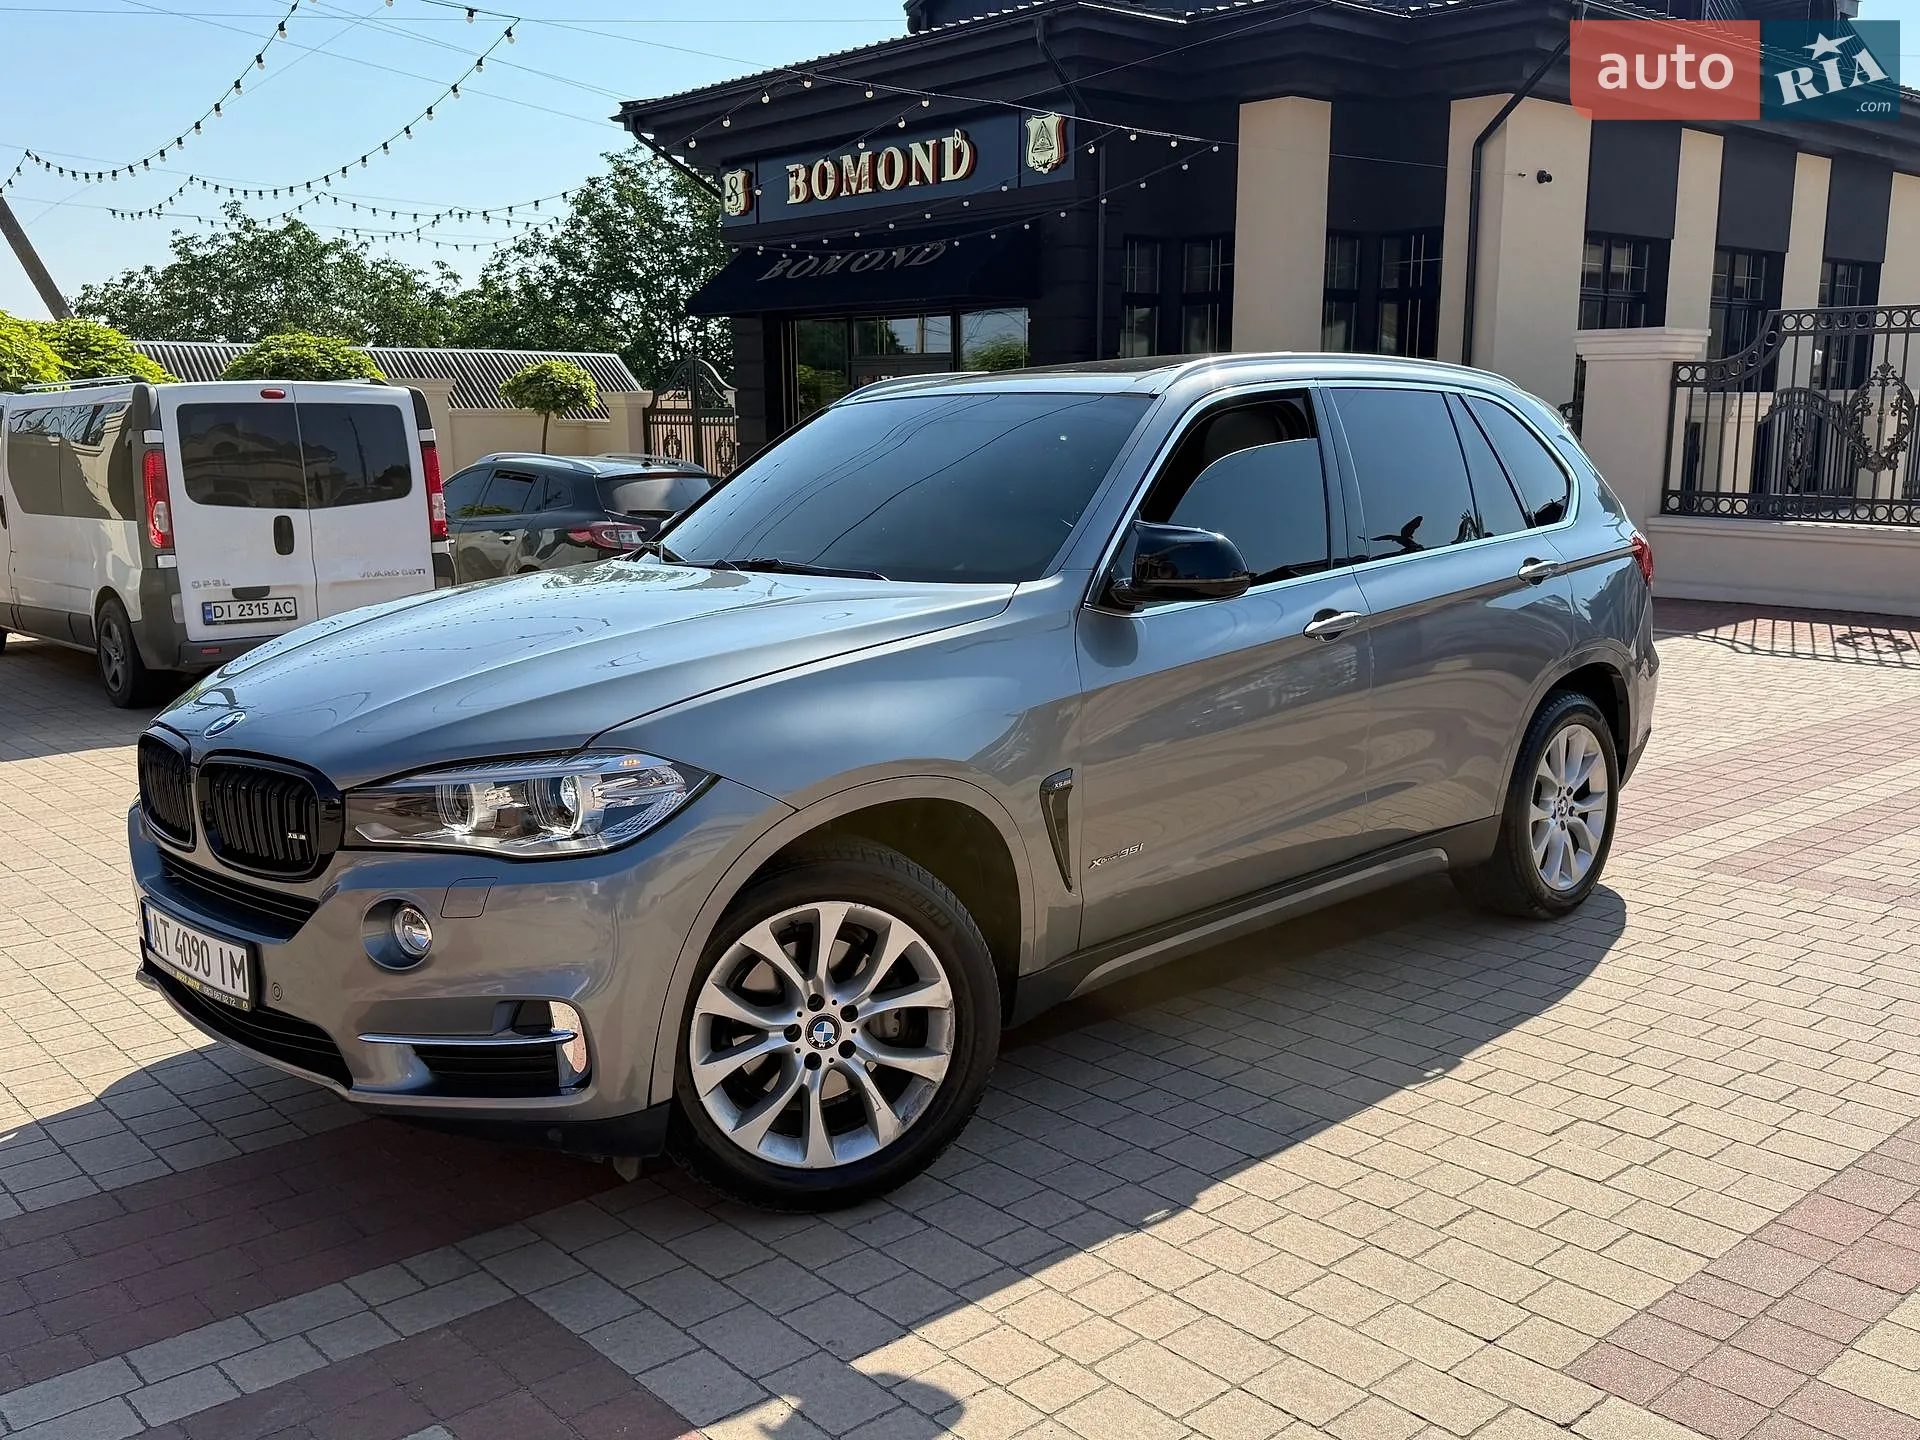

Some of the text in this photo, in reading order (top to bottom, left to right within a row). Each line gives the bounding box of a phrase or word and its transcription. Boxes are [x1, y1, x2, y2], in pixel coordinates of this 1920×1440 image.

[786, 129, 977, 204] BOMOND
[757, 241, 947, 281] BOMOND
[213, 601, 293, 619] DI 2315 AC
[153, 913, 247, 994] AT 4090 IM
[808, 1036, 837, 1048] BMW
